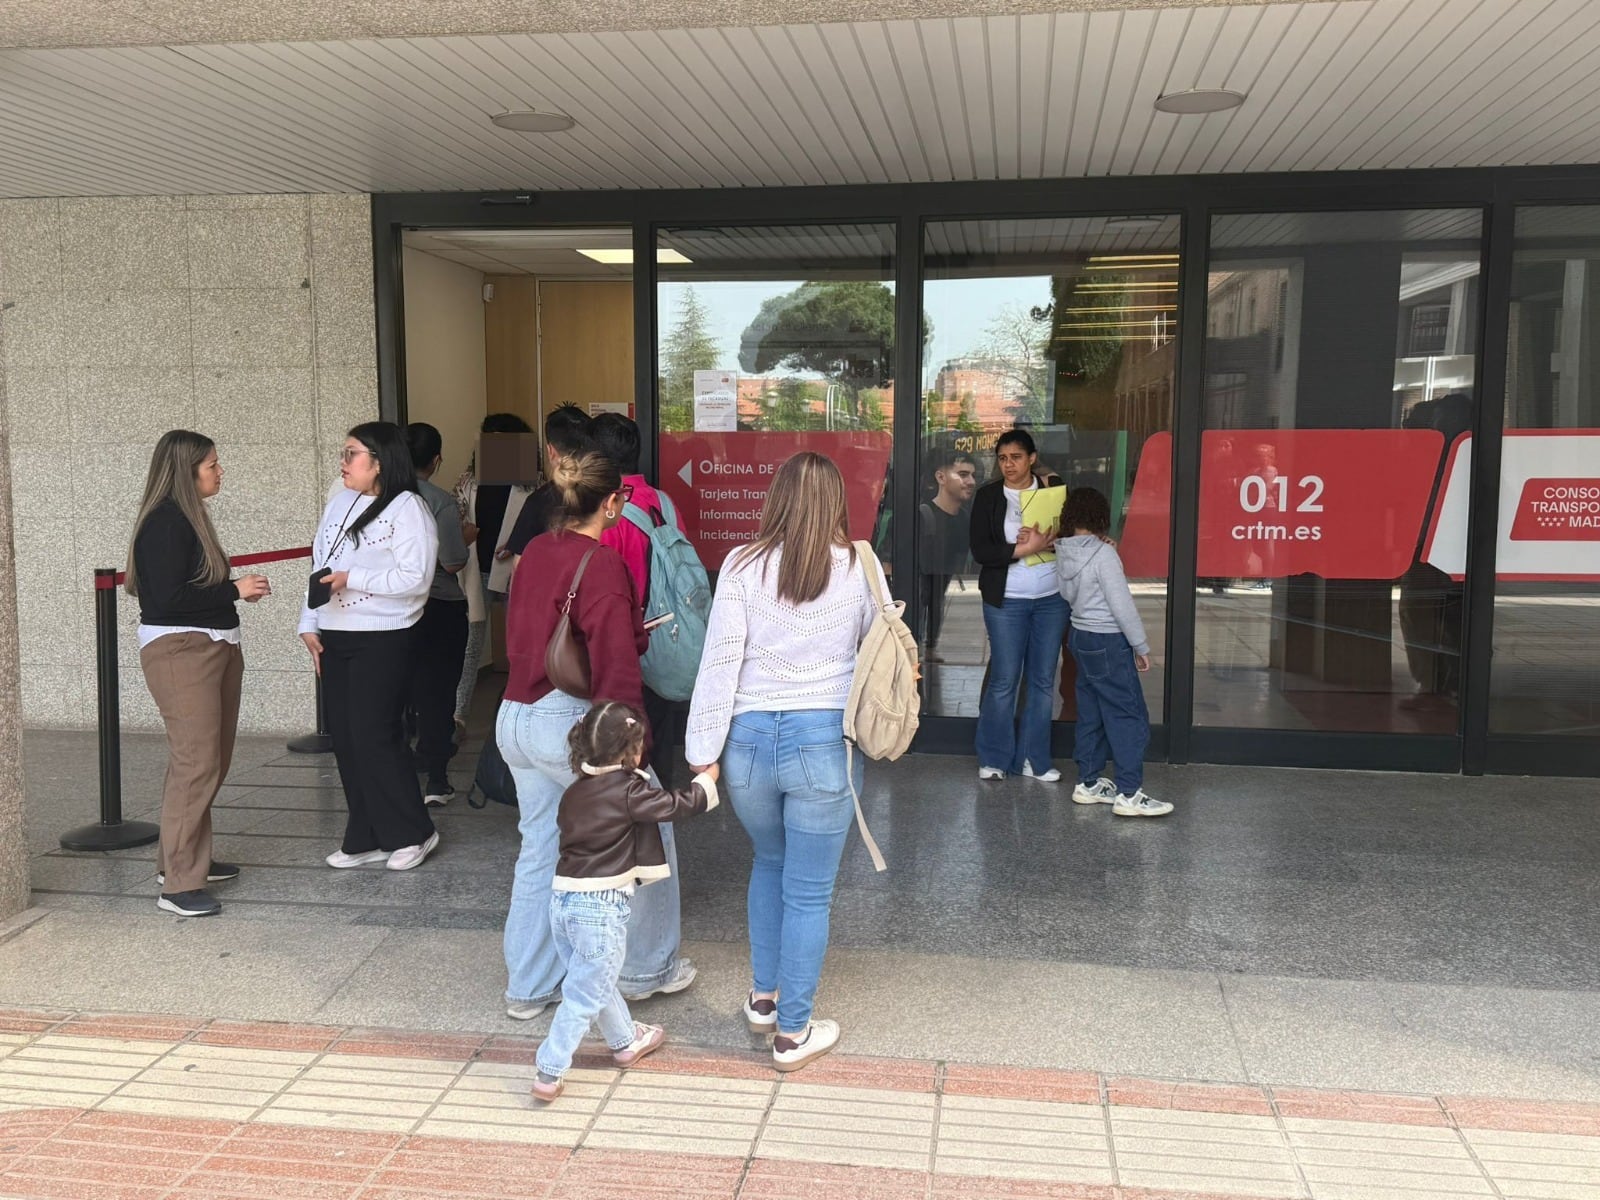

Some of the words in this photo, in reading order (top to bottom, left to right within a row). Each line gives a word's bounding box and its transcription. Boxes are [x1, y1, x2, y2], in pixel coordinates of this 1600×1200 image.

[758, 463, 774, 474] DE
[699, 488, 740, 501] Tarjeta
[1239, 474, 1324, 513] 012
[1543, 487, 1600, 499] CONSO
[1530, 501, 1600, 513] TRANSPO
[1231, 521, 1322, 541] crtm.es
